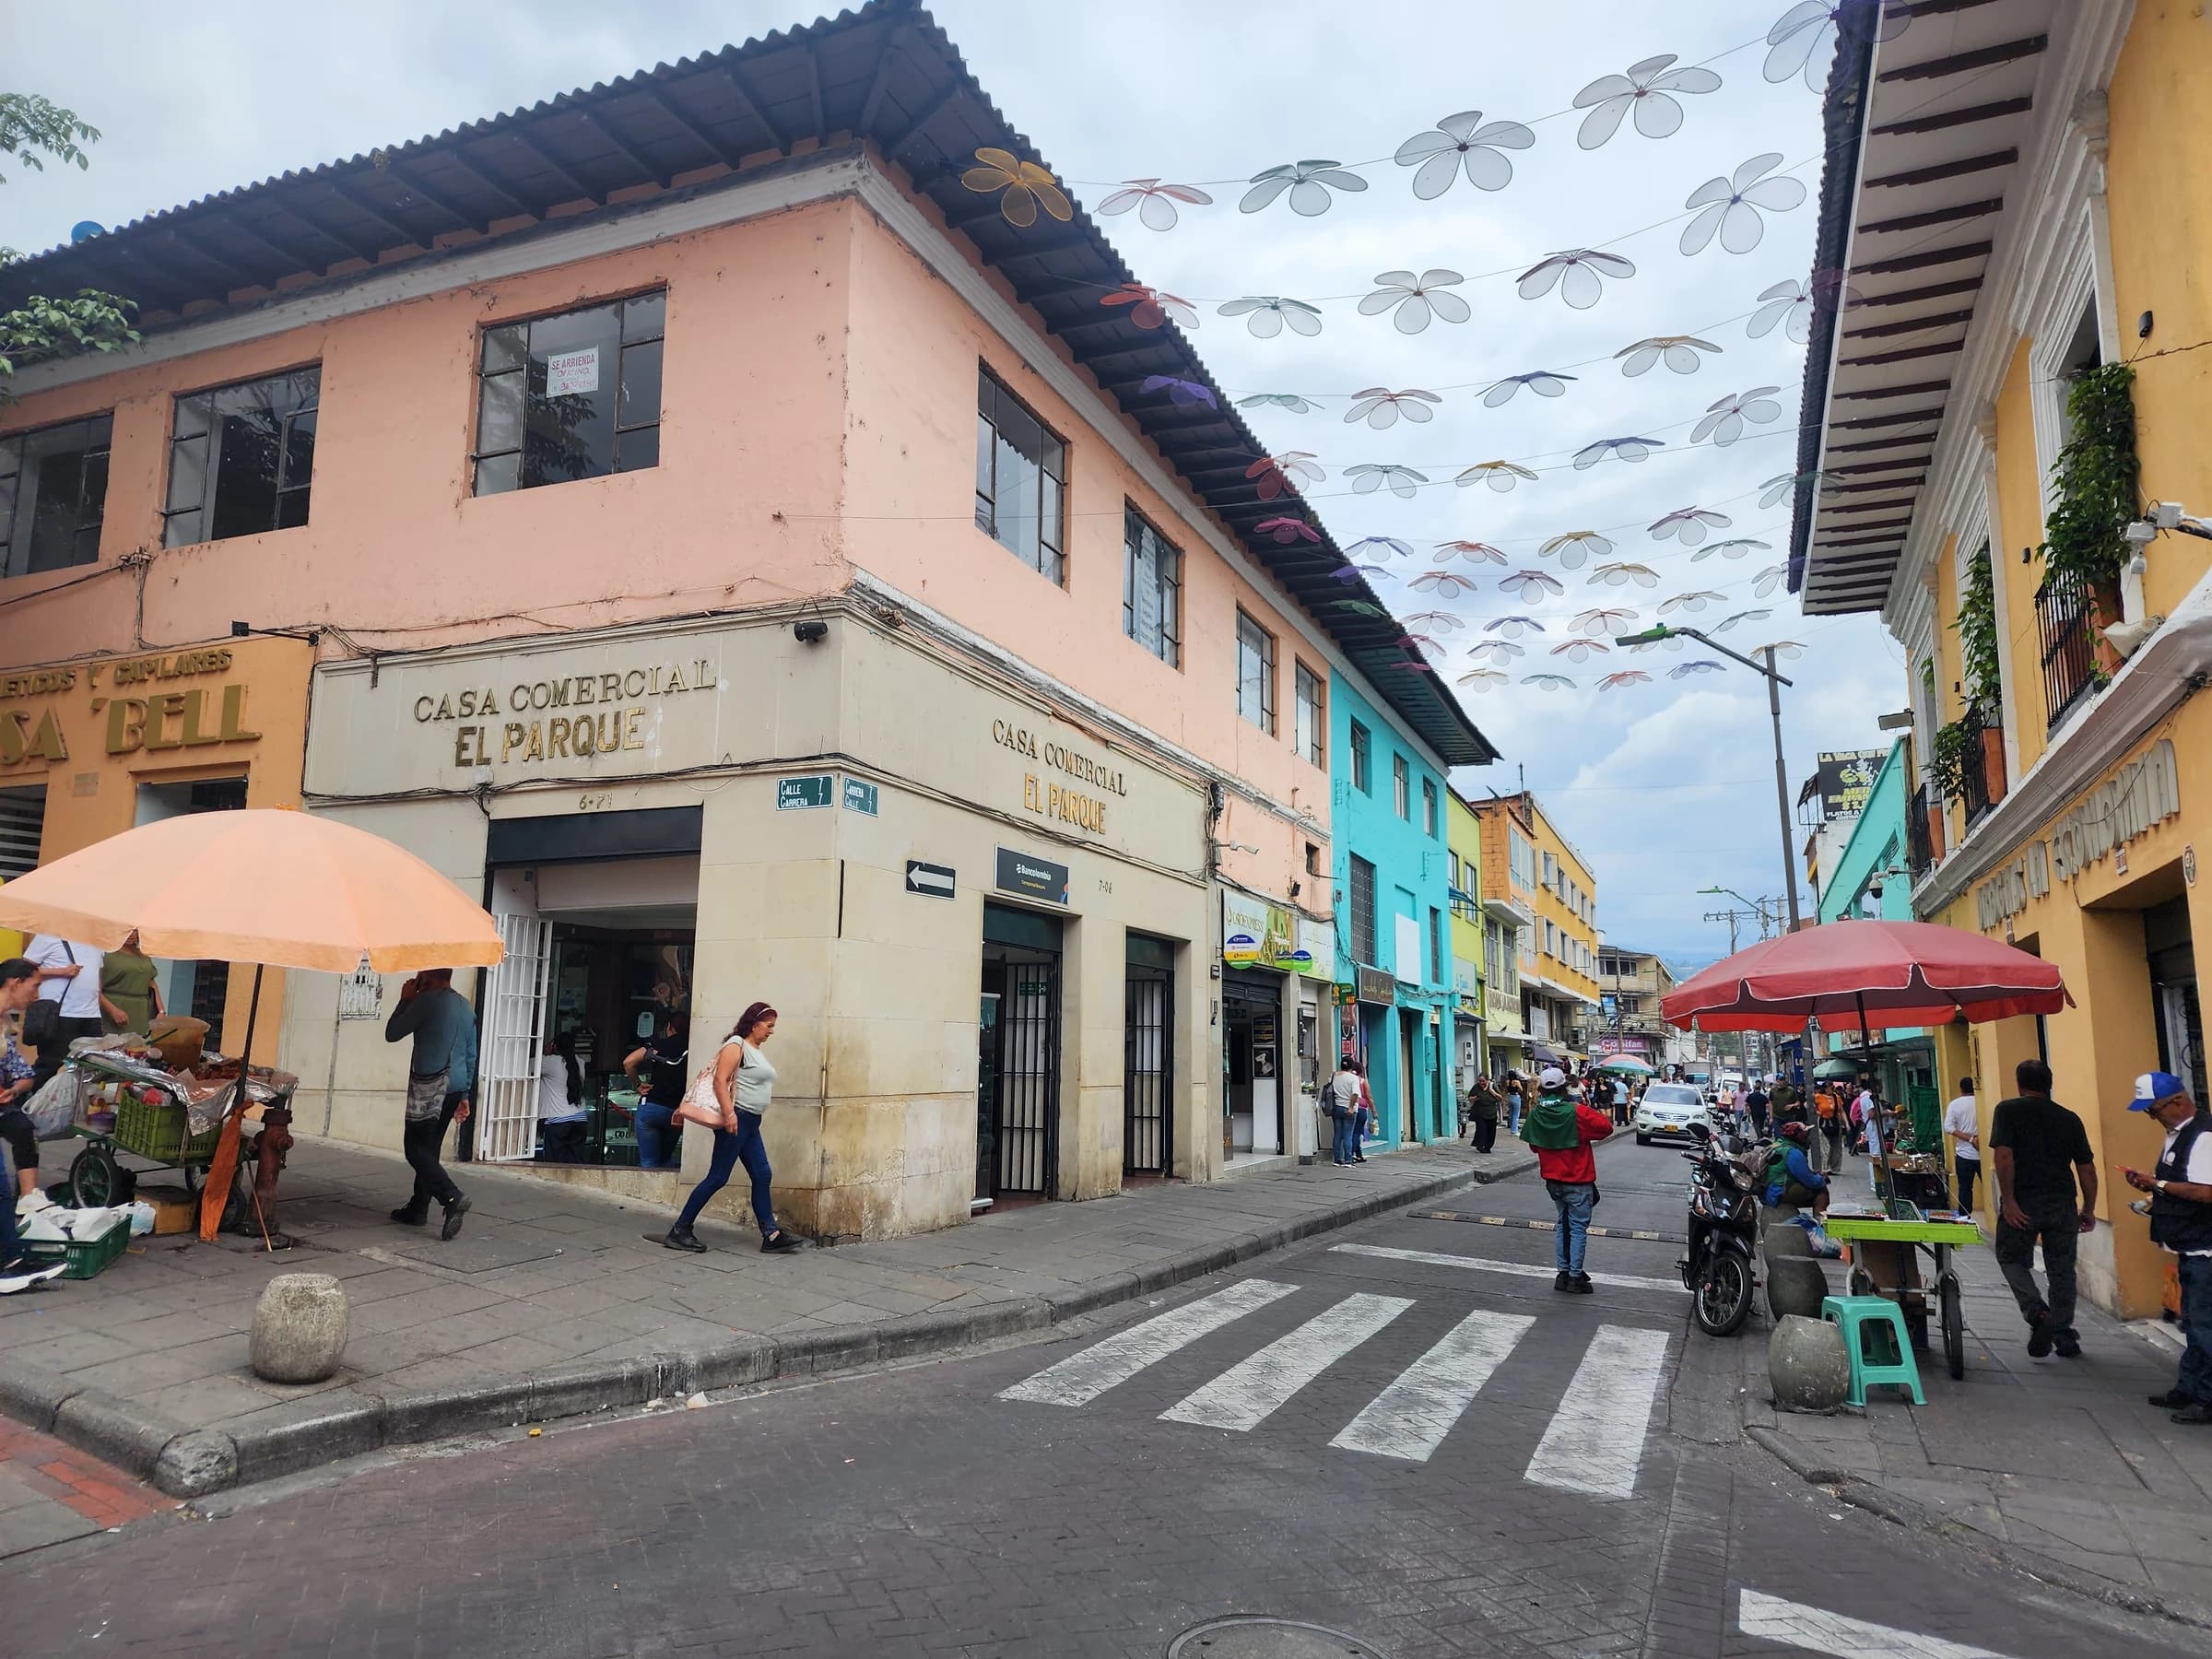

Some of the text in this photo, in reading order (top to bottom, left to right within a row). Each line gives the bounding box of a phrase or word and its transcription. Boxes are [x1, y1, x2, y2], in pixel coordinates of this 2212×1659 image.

[561, 354, 595, 369] ARRIENDA
[88, 664, 104, 688] Y
[113, 649, 233, 685] CAPILARES
[414, 660, 717, 723] CASA COMERCIAL
[455, 707, 645, 767] EL PARQUE
[993, 718, 1127, 796] CASA COMERCIAL
[781, 778, 824, 795] CALLE 7
[869, 786, 873, 801] 7
[780, 793, 823, 807] CARRERA 7
[845, 794, 872, 812] CALLE 7
[1024, 772, 1106, 835] EL PARQUE
[1021, 865, 1052, 881] Bancolombia
